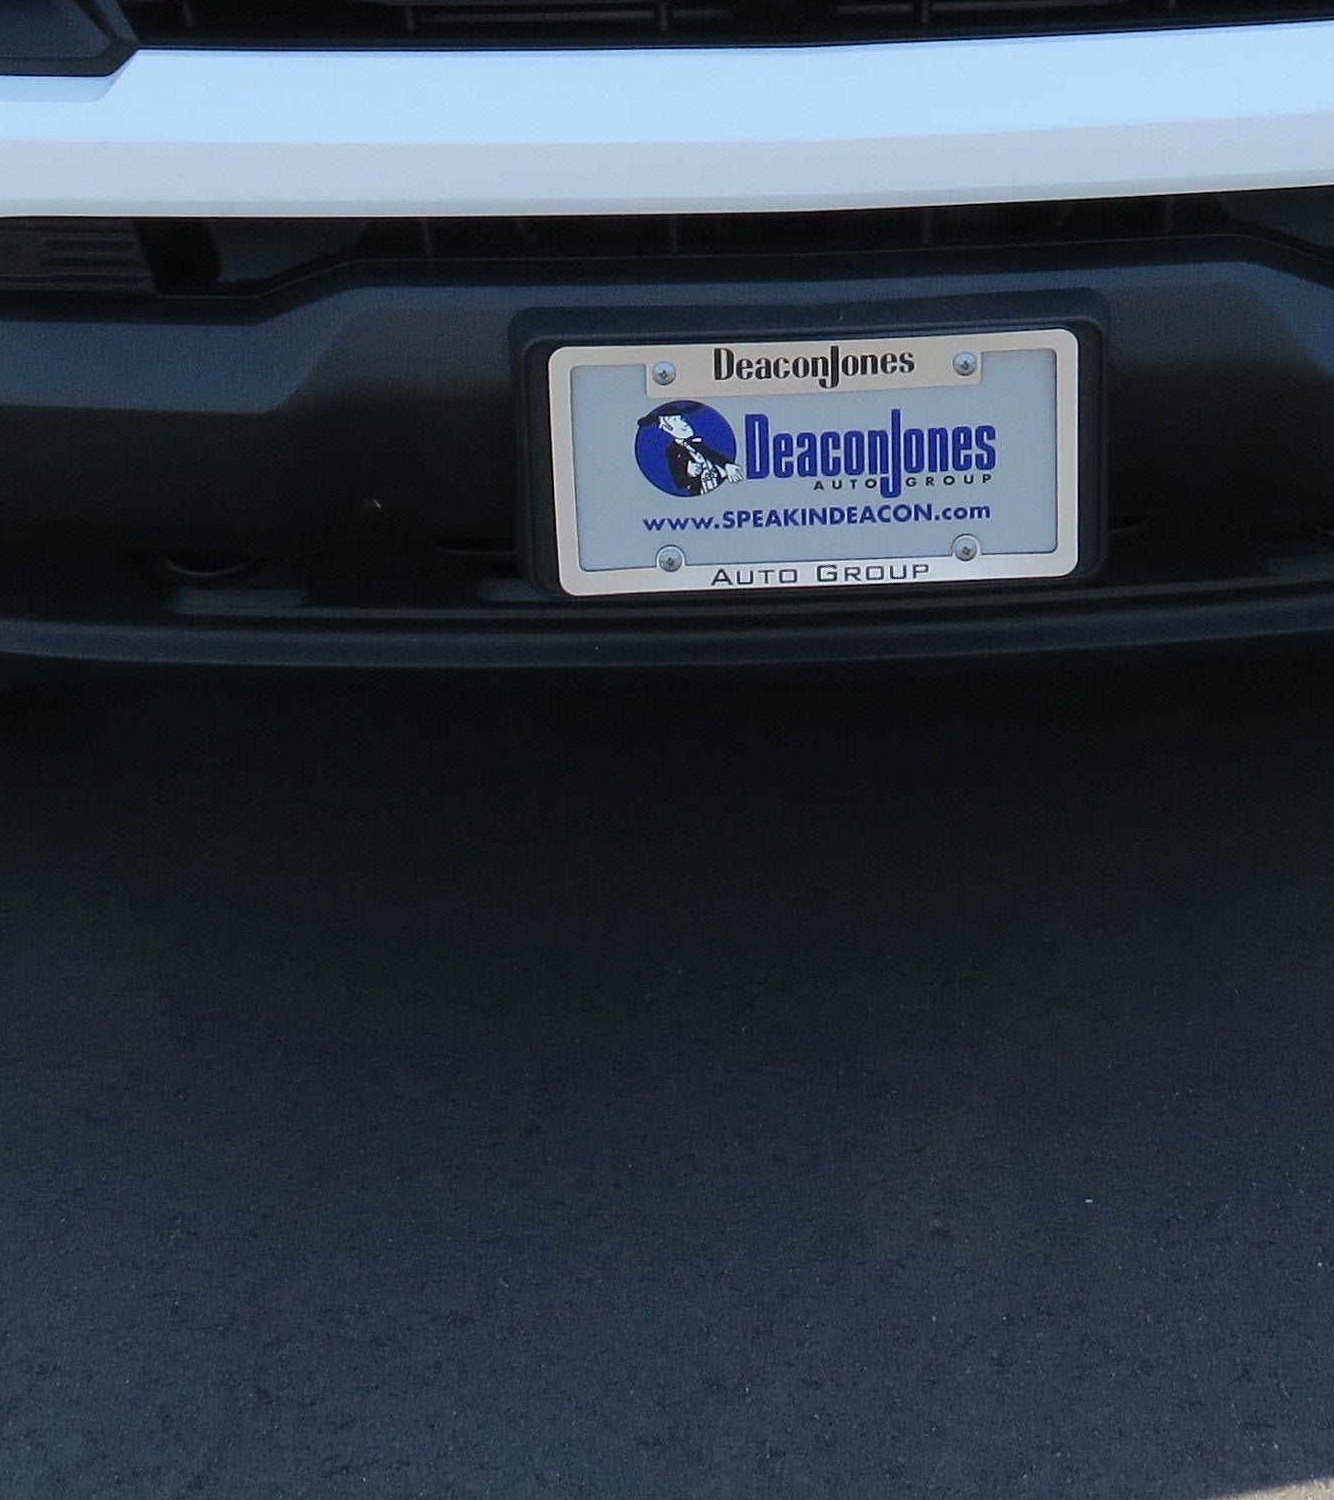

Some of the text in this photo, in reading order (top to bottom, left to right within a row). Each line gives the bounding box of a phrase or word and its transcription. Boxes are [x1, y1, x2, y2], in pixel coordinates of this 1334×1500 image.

[813, 473, 993, 491] AUTO GROUP
[642, 503, 991, 532] www.SPEAKINDEACON.com
